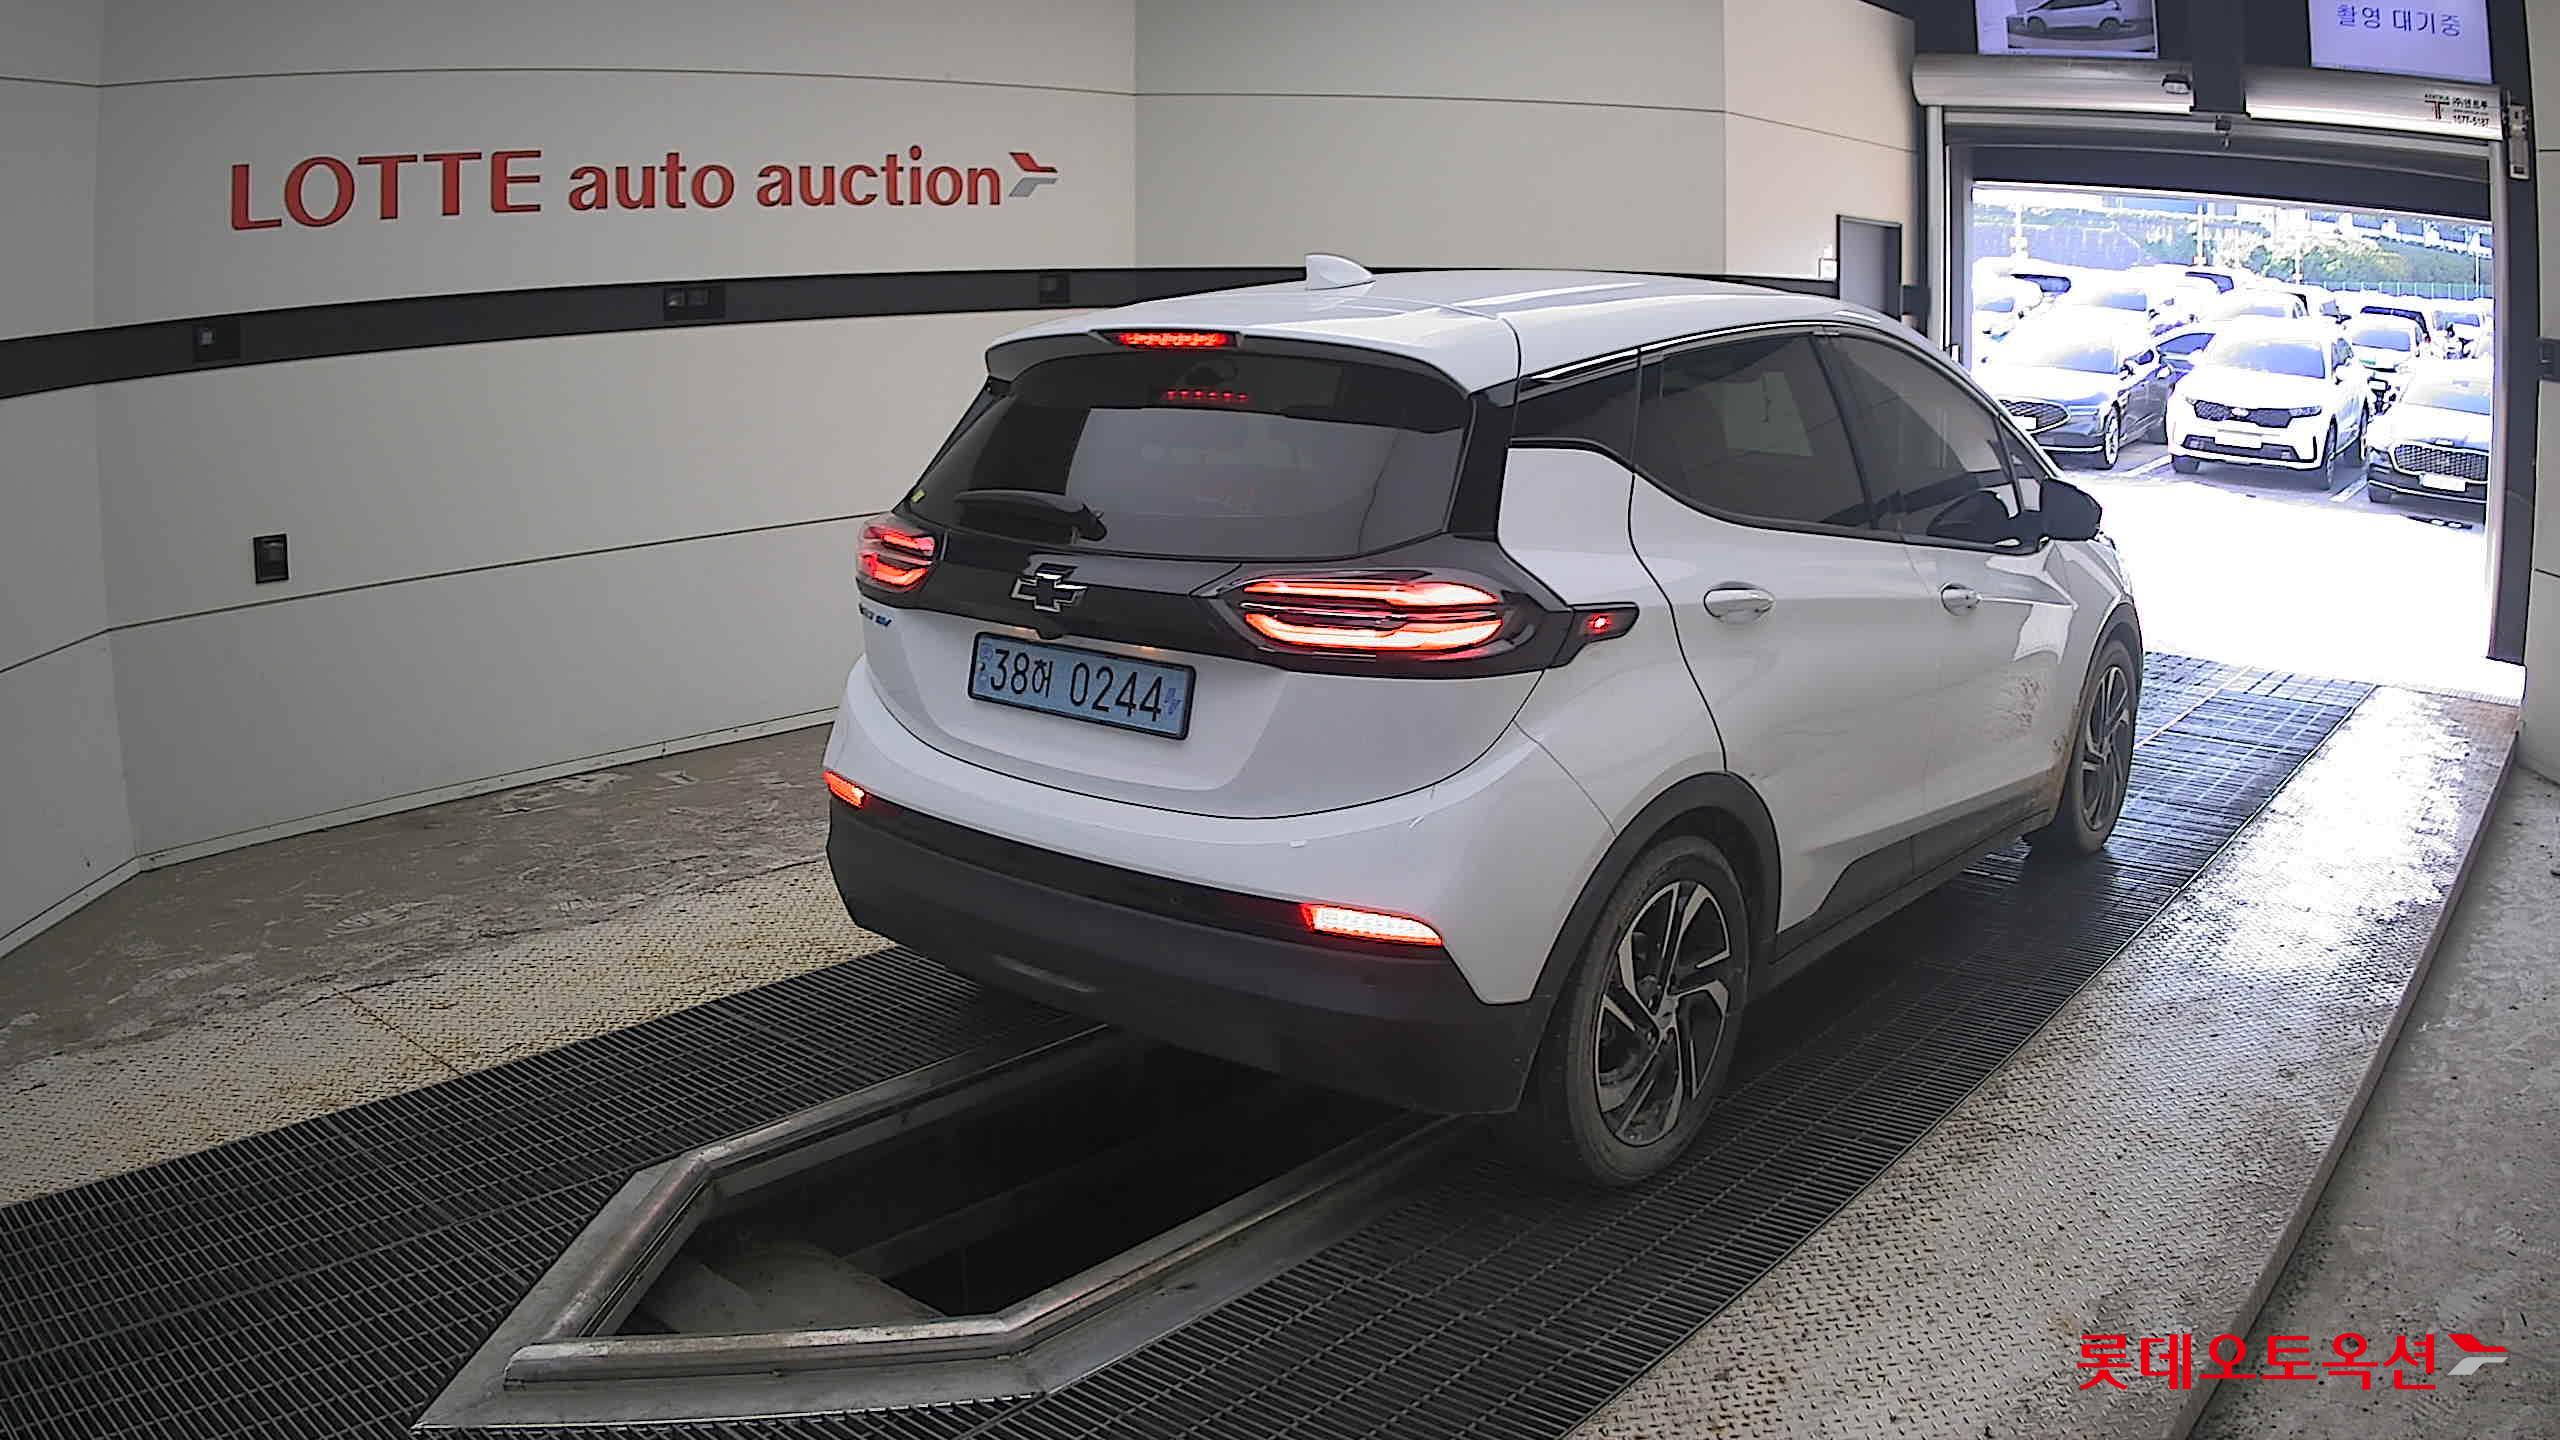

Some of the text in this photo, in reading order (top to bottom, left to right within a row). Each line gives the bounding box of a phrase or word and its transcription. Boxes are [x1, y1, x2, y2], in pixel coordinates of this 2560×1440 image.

[2337, 4, 2461, 37] 촬영 대기중
[231, 145, 1002, 231] LOTTE auto auction
[1069, 662, 1163, 722] 0244
